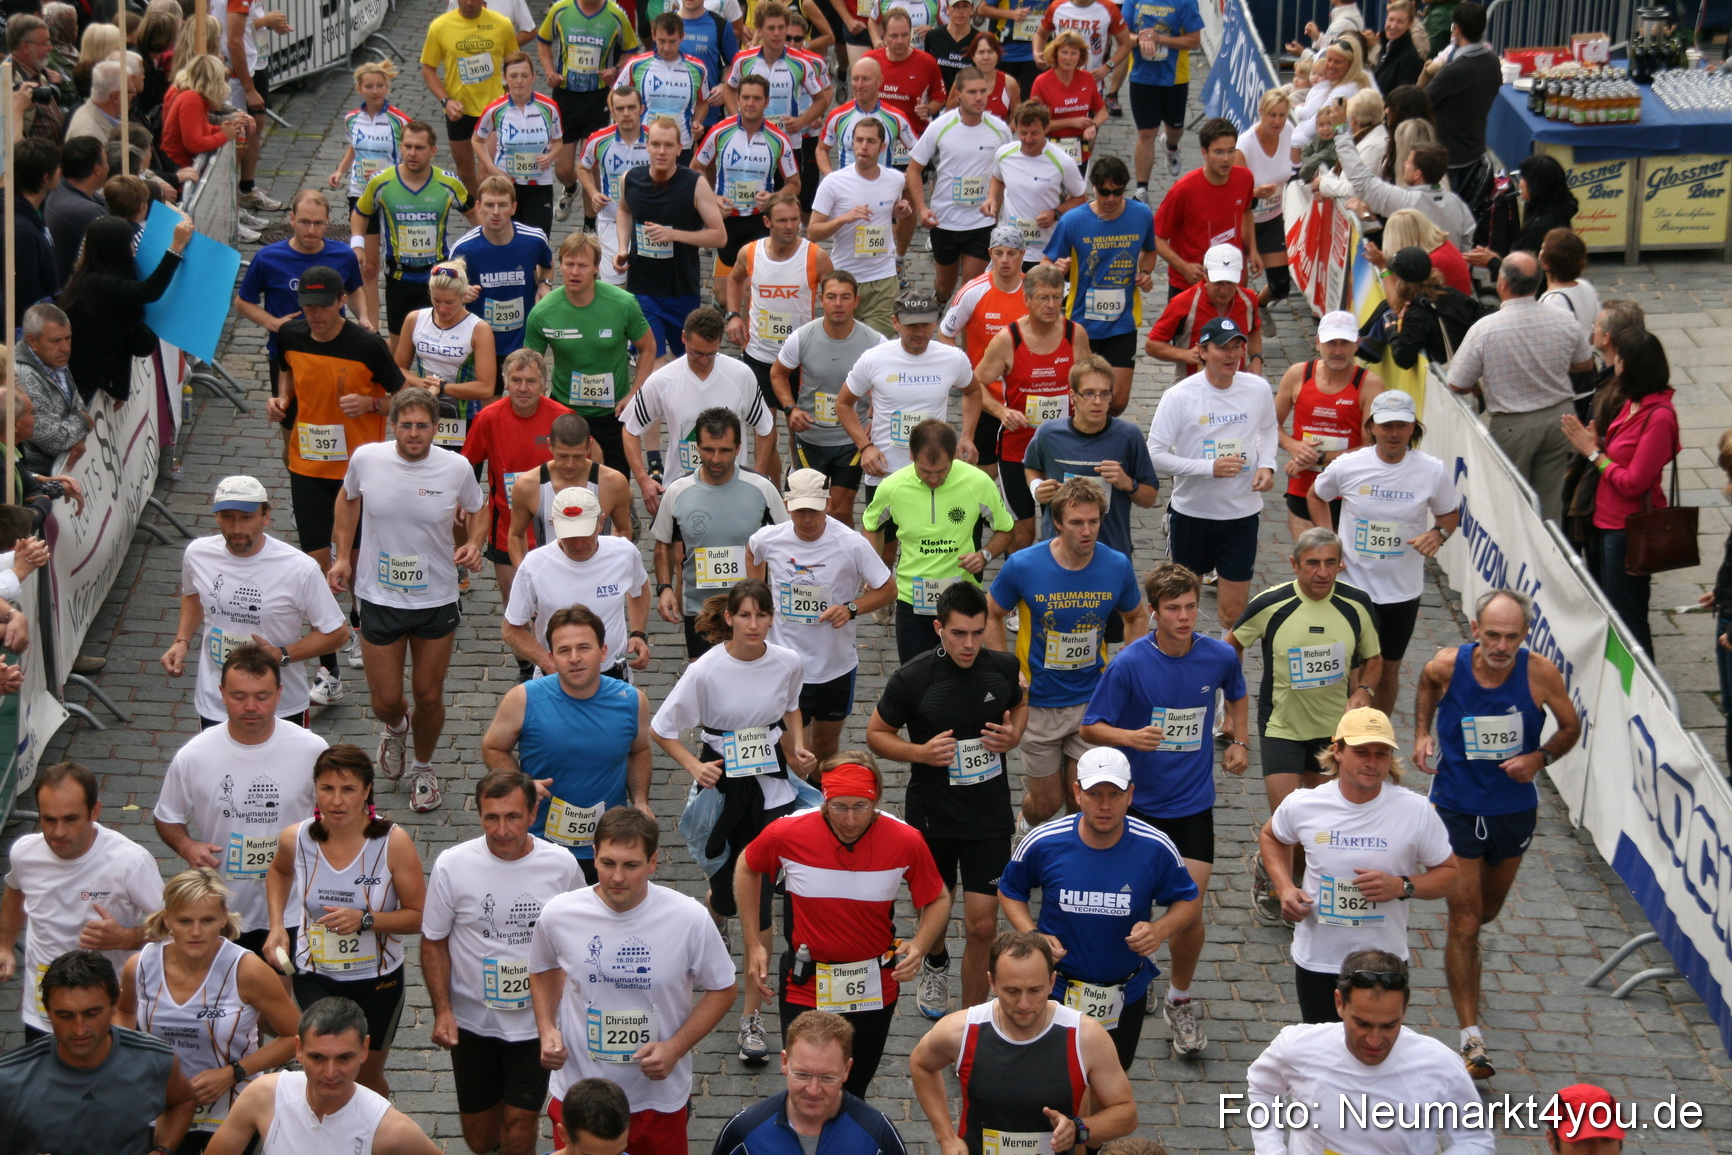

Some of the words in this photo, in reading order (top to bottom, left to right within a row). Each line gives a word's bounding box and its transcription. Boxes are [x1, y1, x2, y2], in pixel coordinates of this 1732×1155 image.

[1059, 19, 1101, 31] MERZ
[567, 35, 604, 46] BOCK
[578, 58, 595, 66] 611
[469, 64, 490, 75] 3690
[1054, 104, 1089, 115] Röthenbach
[516, 162, 539, 171] 2656
[1566, 162, 1627, 187] lossner
[1645, 160, 1729, 202] Glossner
[963, 187, 984, 196] 2947
[1587, 183, 1624, 200] Bier
[1687, 183, 1726, 200] Bier
[395, 212, 438, 221] BOCK
[407, 228, 427, 236] Markus
[866, 228, 881, 236] Volker
[1020, 230, 1041, 238] 946
[412, 238, 431, 248] 614
[869, 238, 884, 247] 560
[1082, 236, 1091, 244] 10.
[1093, 234, 1140, 244] NEUMARKTER
[1092, 241, 1131, 249] STADTLAUF
[480, 271, 524, 283] HUBER
[759, 286, 800, 299] DAK
[1096, 301, 1121, 311] 6093
[496, 310, 520, 321] 2390
[769, 314, 782, 322] Hans
[772, 325, 793, 335] 568
[417, 341, 464, 358] BOCK
[583, 387, 609, 397] 2634
[1039, 399, 1058, 407] Ludwig
[903, 414, 921, 422] Alfred
[1041, 409, 1062, 419] 637
[309, 427, 331, 436] Hubert
[437, 423, 459, 434] 610
[315, 438, 337, 449] 397
[1218, 442, 1235, 450] Armin
[1371, 524, 1390, 532] Marco
[1370, 535, 1401, 547] 3619
[708, 550, 729, 560] Rudolf
[919, 546, 959, 554] Apotheke
[391, 559, 416, 568] Günther
[714, 562, 739, 575] 638
[392, 570, 423, 581] 3070
[596, 583, 619, 594] ATSV
[925, 582, 939, 590] Rudi
[793, 588, 812, 597] Mario
[1049, 592, 1112, 602] NEUMARKTER
[794, 599, 828, 612] 2036
[1047, 600, 1100, 609] STADTLAUF
[221, 610, 261, 620] Neumarkter
[230, 617, 261, 626] Stadtlauf
[1061, 636, 1088, 644] Mathias
[1065, 646, 1090, 659] 206
[1304, 649, 1331, 658] Richard
[1306, 659, 1340, 674] 3265
[1168, 712, 1197, 722] Queitsch
[1166, 724, 1198, 737] 2715
[738, 732, 767, 743] Katharina
[1481, 731, 1517, 744] 3782
[741, 744, 771, 759] 2716
[962, 743, 983, 753] Jonas
[965, 752, 996, 769] 3635
[236, 810, 278, 819] Neumarkter
[564, 806, 596, 819] Gerhard
[568, 822, 596, 834] 550
[1329, 830, 1388, 847] HÄRTEIS
[246, 839, 278, 849] Manfred
[1337, 882, 1361, 892] Herm
[1059, 888, 1131, 909] HUBER
[1338, 896, 1377, 910] 3621
[1074, 906, 1130, 916] TECHNOLOGY
[508, 937, 532, 945] Stadtla
[338, 939, 360, 954] 82
[615, 956, 651, 964] 16.09.2007
[833, 966, 869, 977] Clemens
[589, 974, 601, 983] 8.
[603, 976, 651, 984] Neumarkter
[615, 982, 651, 990] Stadtlauf
[845, 980, 866, 996] 65
[1083, 986, 1107, 1000] Ralph
[1086, 1003, 1113, 1017] 281
[605, 1015, 649, 1026] Christoph
[607, 1030, 650, 1044] 2205
[177, 1040, 200, 1050] Velburg
[1002, 1136, 1038, 1148] Werner
